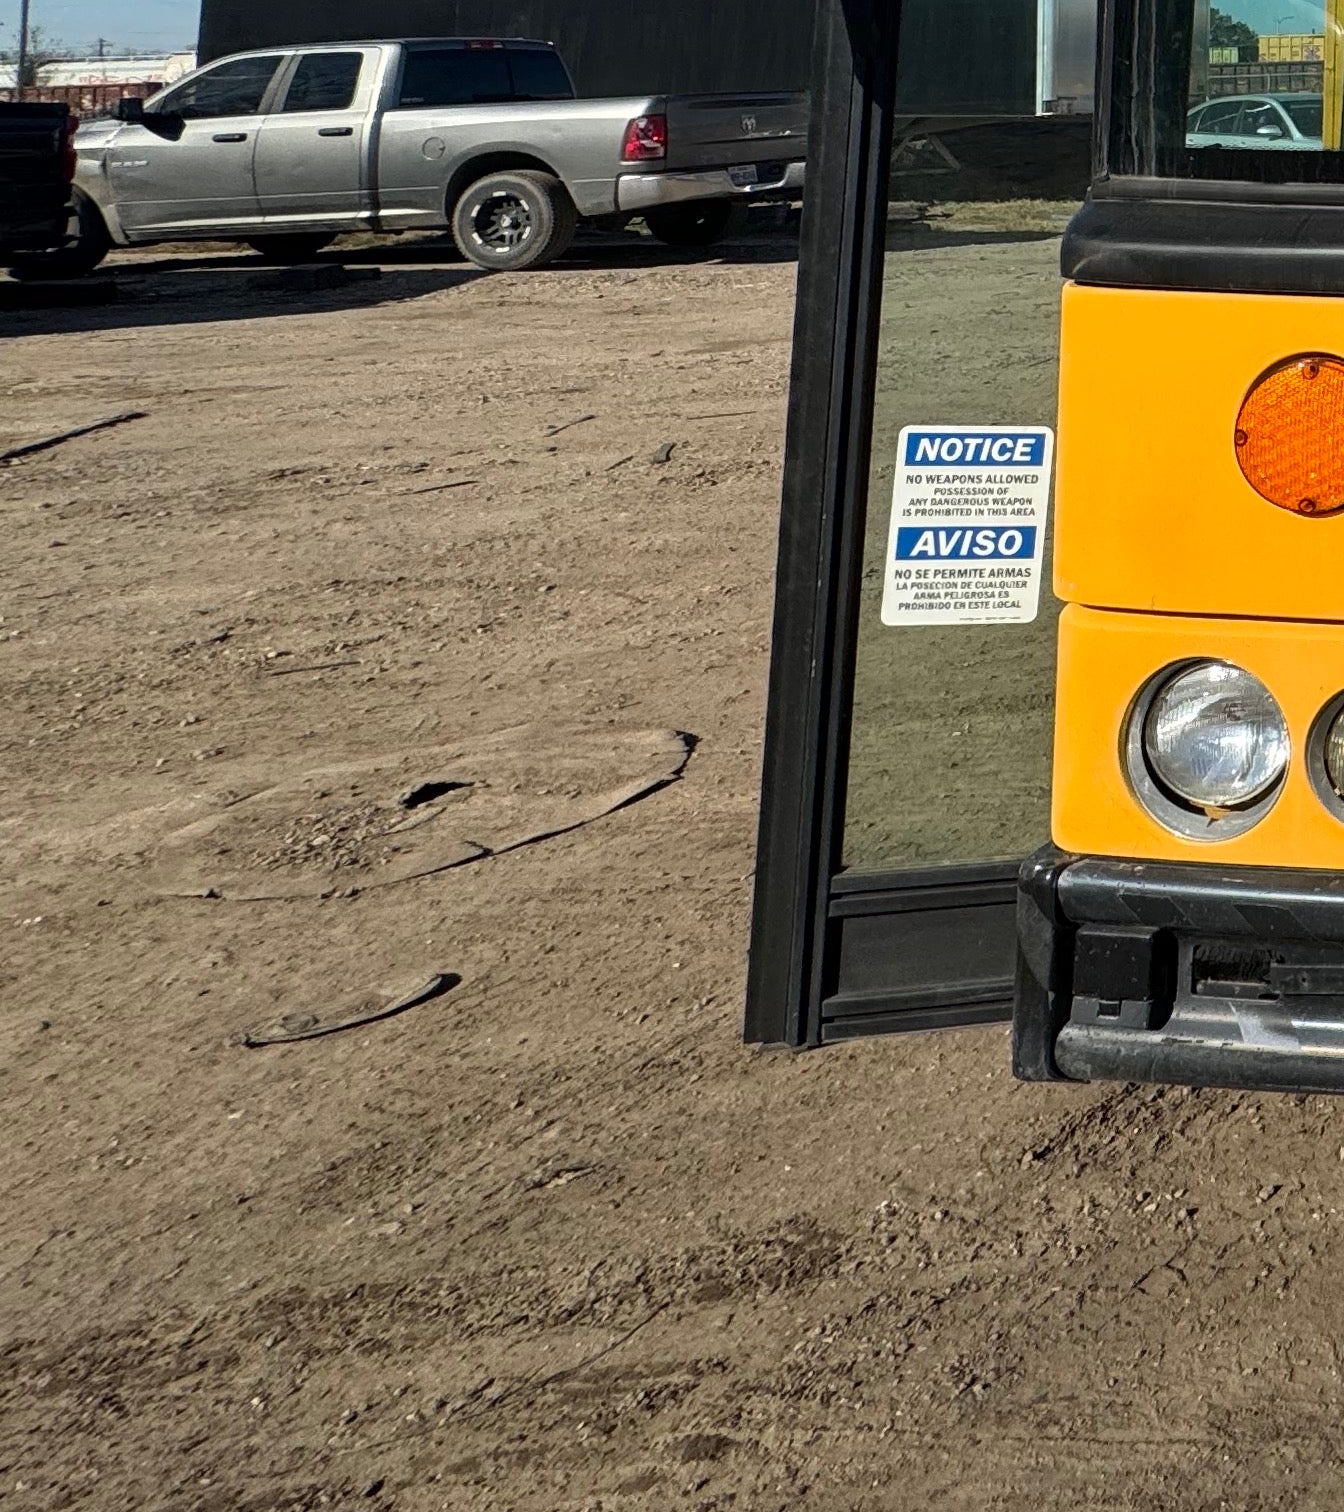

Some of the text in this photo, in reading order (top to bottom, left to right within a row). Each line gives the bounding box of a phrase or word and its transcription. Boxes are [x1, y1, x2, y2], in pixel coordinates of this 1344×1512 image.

[915, 438, 1036, 462] NOTICE
[906, 474, 1039, 484] NO WEAPONS ALLOWED
[934, 487, 1010, 496] POSSESSION OF
[908, 498, 1032, 506] ANY DANGEROUS WEAPON
[902, 508, 1035, 516] IS PROHIBITED IN THIS AREA
[910, 529, 1023, 556] AVISO
[894, 567, 1032, 579] NO SE PERMITE ARMAS
[896, 582, 908, 590] LA
[960, 581, 972, 589] DE
[974, 580, 1028, 589] CUALQUIER
[913, 592, 941, 600] ARMA
[943, 591, 995, 600] PELIGROSA
[898, 602, 951, 610] PROHIBIDO
[968, 601, 990, 609] ESTE
[992, 600, 1021, 609] LOCAL
